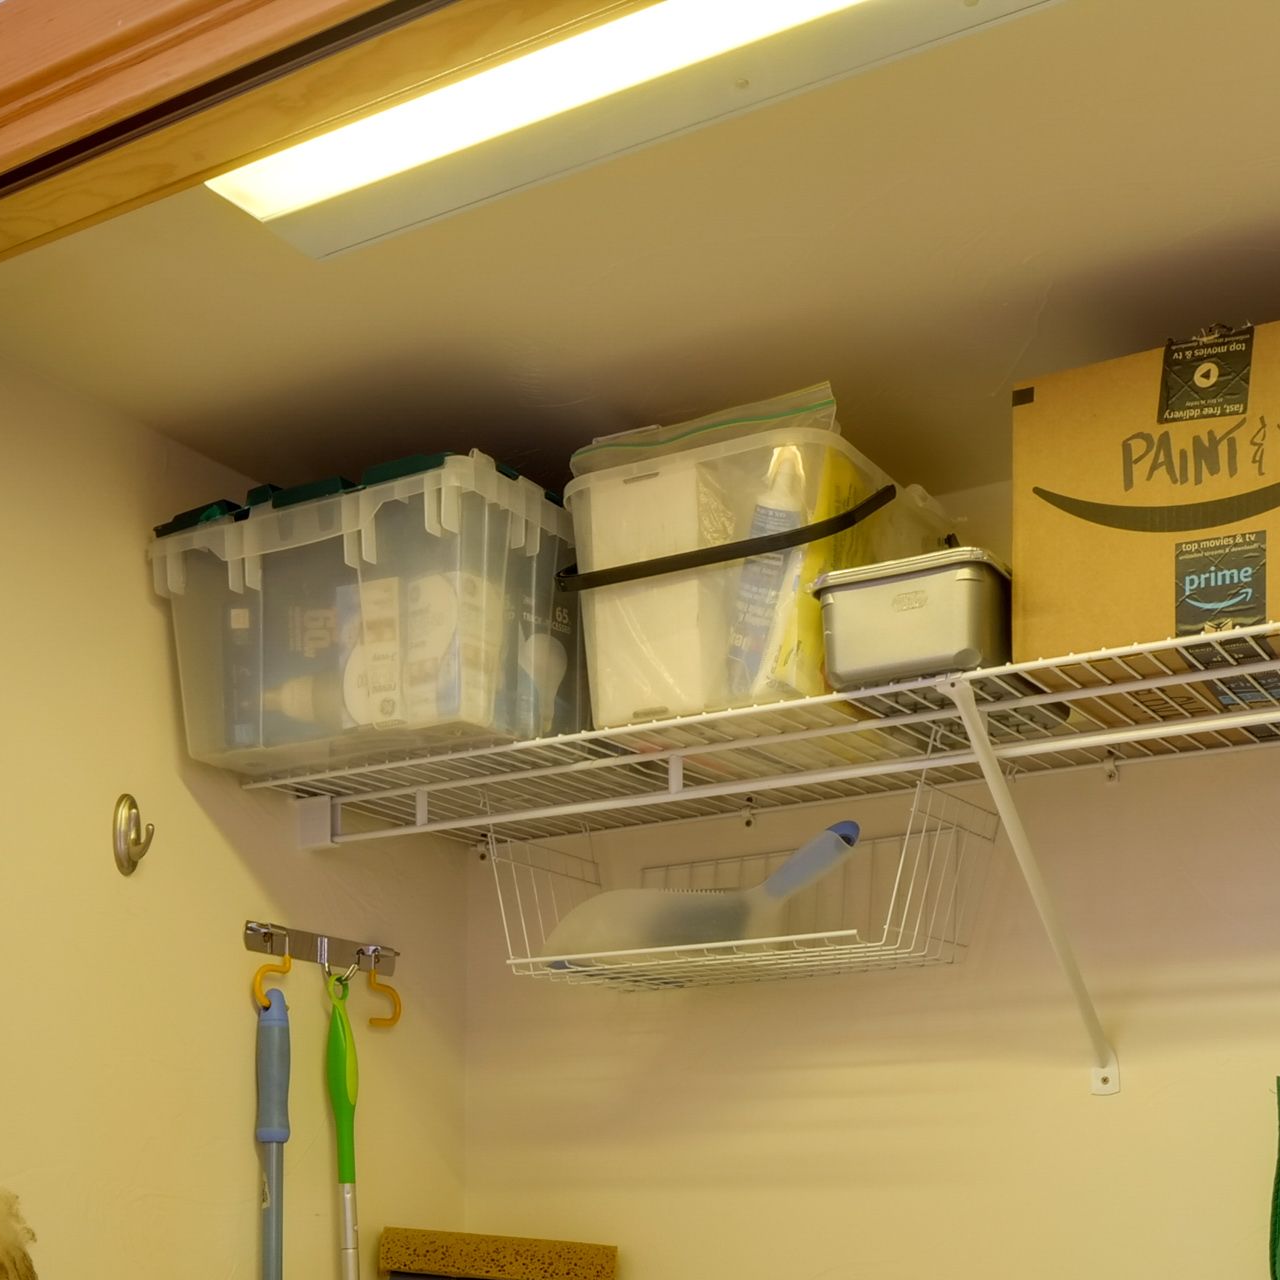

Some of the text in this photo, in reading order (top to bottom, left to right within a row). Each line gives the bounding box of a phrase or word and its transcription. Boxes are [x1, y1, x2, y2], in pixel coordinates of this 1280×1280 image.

[1194, 344, 1227, 357] movies
[1229, 342, 1246, 351] top
[1163, 403, 1244, 420] fast, free delivery
[1121, 417, 1247, 492] PAINT
[1181, 533, 1256, 551] top movies & tv
[1184, 566, 1253, 595] prime
[555, 607, 569, 624] 65
